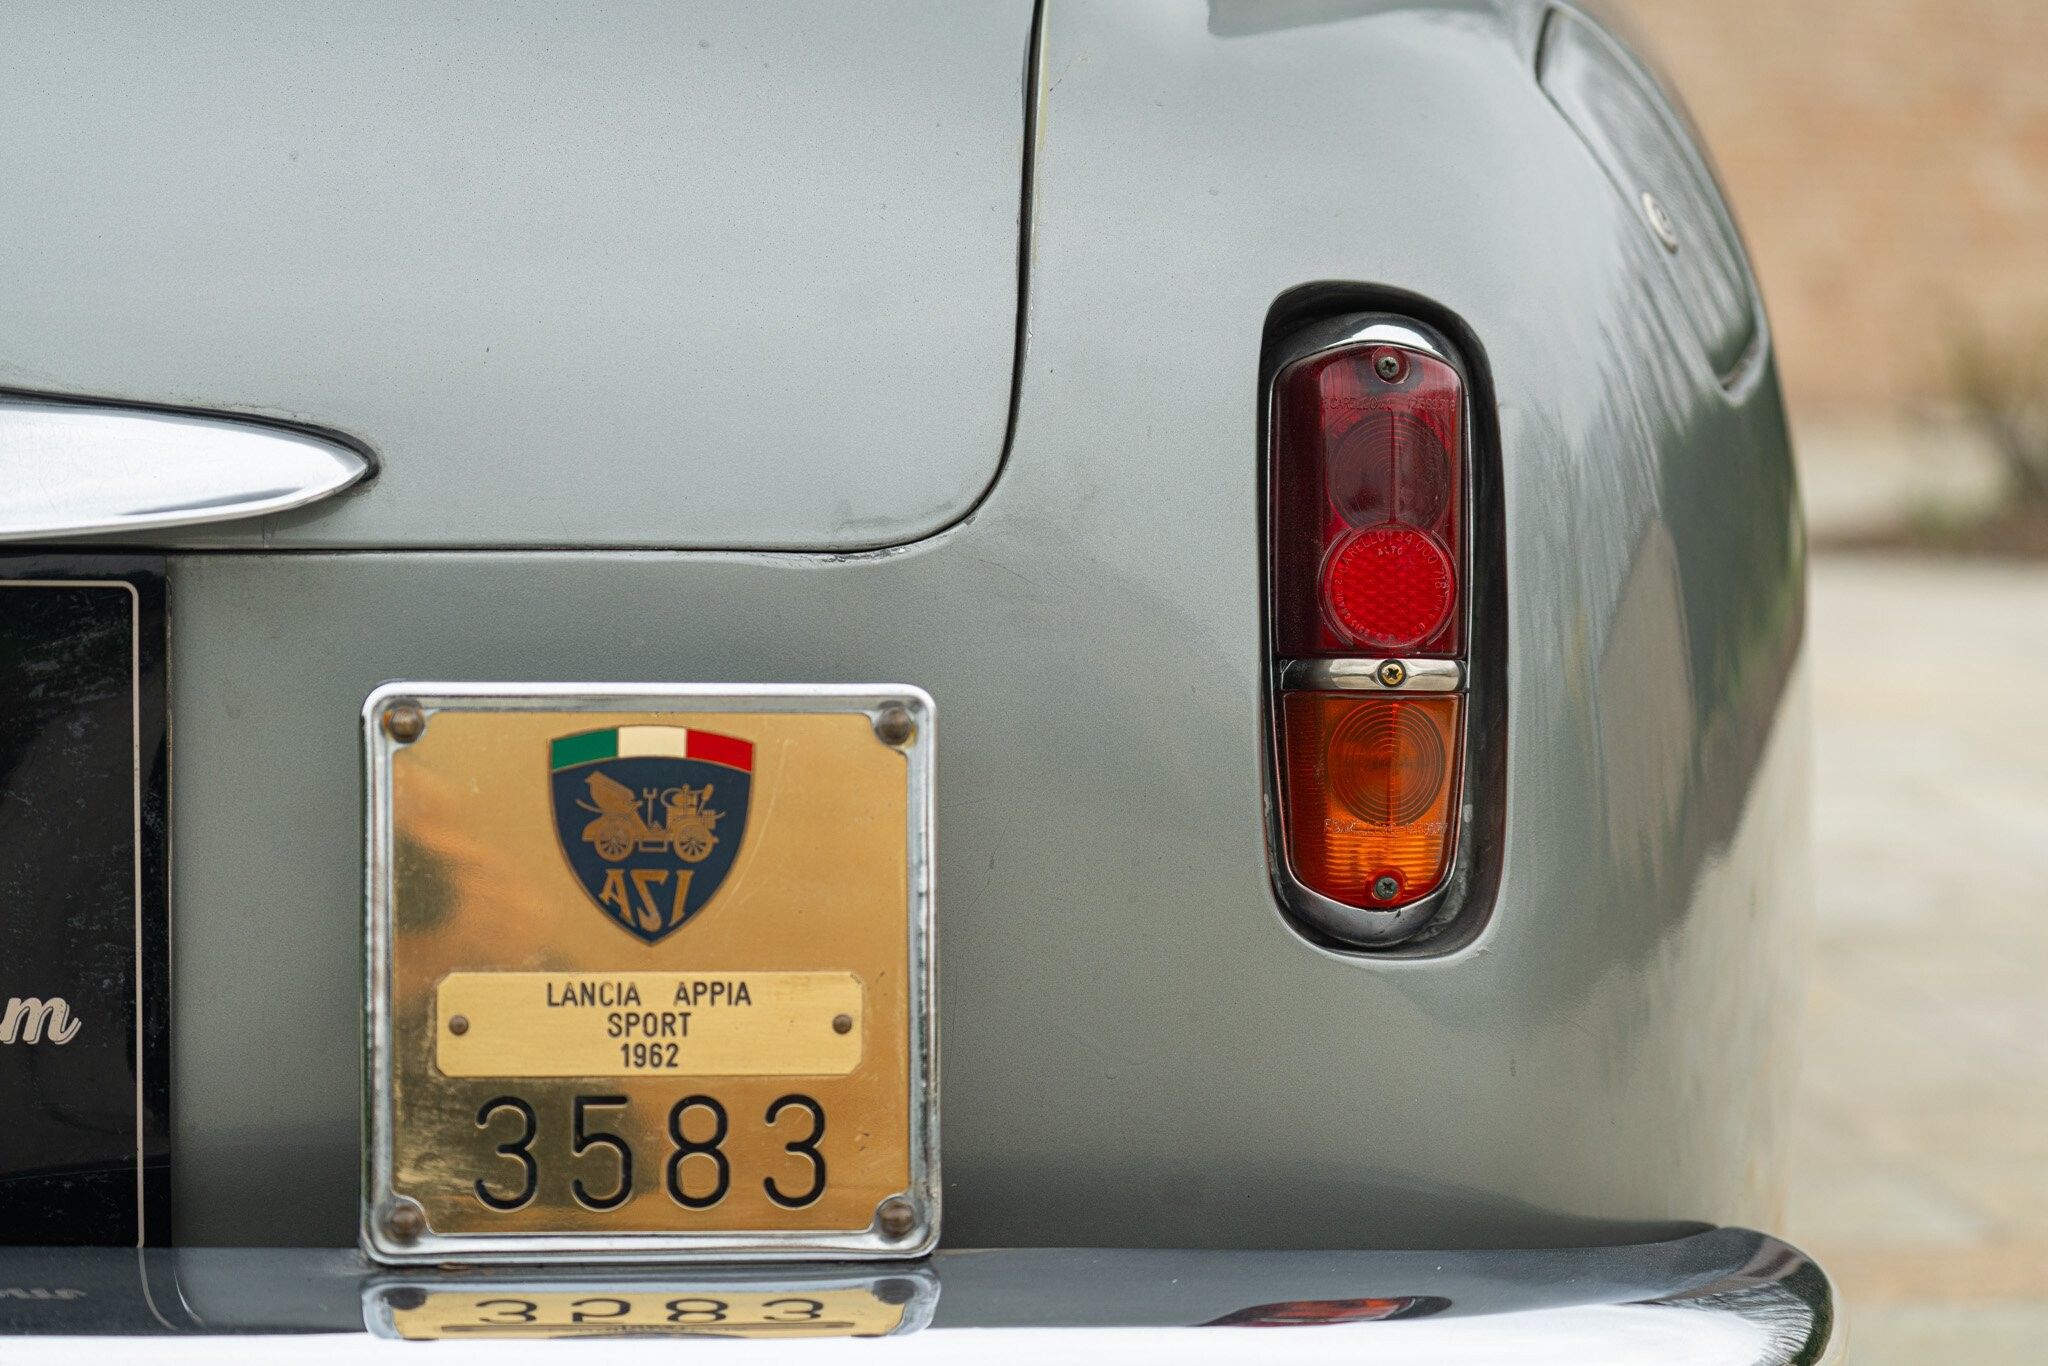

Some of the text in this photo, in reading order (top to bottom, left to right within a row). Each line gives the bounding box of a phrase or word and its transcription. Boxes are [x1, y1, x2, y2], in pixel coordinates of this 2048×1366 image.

[599, 868, 695, 932] ASI
[547, 981, 752, 1007] LANCIA APPIA
[607, 1012, 692, 1038] SPORT
[621, 1043, 680, 1069] 1962
[474, 1095, 826, 1211] 3583
